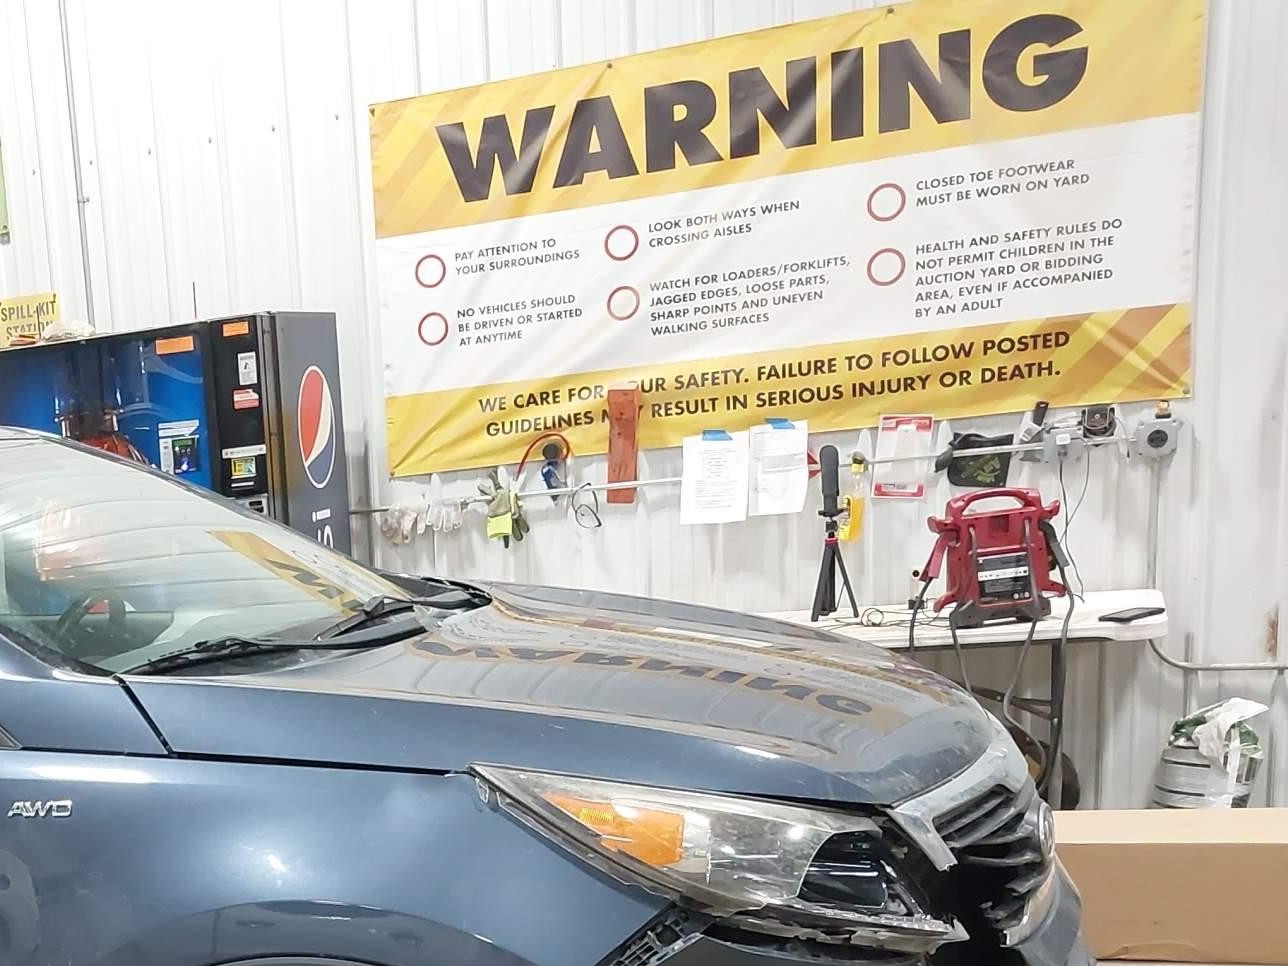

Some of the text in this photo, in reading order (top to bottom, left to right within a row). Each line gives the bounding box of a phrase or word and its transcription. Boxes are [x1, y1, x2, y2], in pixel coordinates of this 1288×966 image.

[436, 12, 1089, 203] WARNING
[916, 159, 1074, 190] CLOSED TOE FOOTWEAR
[916, 174, 1090, 207] MUST BE WORN ON YARD
[648, 200, 800, 233] LOOK BOTH WAYS WHEN
[455, 238, 556, 262] PAY ATTENTION TO
[648, 223, 752, 248] CROSSING AISLES
[916, 218, 1122, 256] HEALTH AND SAFETY RULES DO
[456, 250, 580, 276] YOUR SURROUNDINGS
[916, 236, 1114, 272] NOT PERMIT CHILDREN IN THE
[916, 254, 1104, 286] AUCTION YARD OR BIDDING
[650, 256, 851, 292] WATCH FOR LOADERS/FORKLIFTS,
[915, 268, 1113, 303] AREA, EVEN IF ACCOMPANIED
[457, 294, 576, 318] NO VEHICLES SHOULD
[650, 274, 830, 307] JAGGED EDGES, LOOSE PARTS,
[650, 290, 824, 322] SHARP POINTS AND UNEVEN
[458, 308, 582, 332] BE DRIVEN OR STARTED
[651, 312, 770, 336] WALKING SURFACES
[915, 298, 1003, 318] BY AN ADULT
[459, 330, 523, 346] AT ANYTIME
[478, 396, 507, 414] WE
[513, 389, 560, 410] CARE
[568, 384, 605, 403] FOR
[674, 367, 749, 390] SAFETY.
[757, 358, 837, 381] FAILURE
[845, 353, 873, 371] TO
[881, 342, 975, 368] FOLLOW
[983, 331, 1070, 356] POSTED
[486, 411, 594, 437] GUIDELINES
[651, 398, 718, 418] RESULT
[726, 394, 748, 410] IN
[756, 384, 844, 410] SERIOUS
[852, 374, 932, 398] INJURY
[939, 370, 972, 388] OR
[981, 361, 1061, 384] DEATH.
[8, 800, 72, 818] AWD
